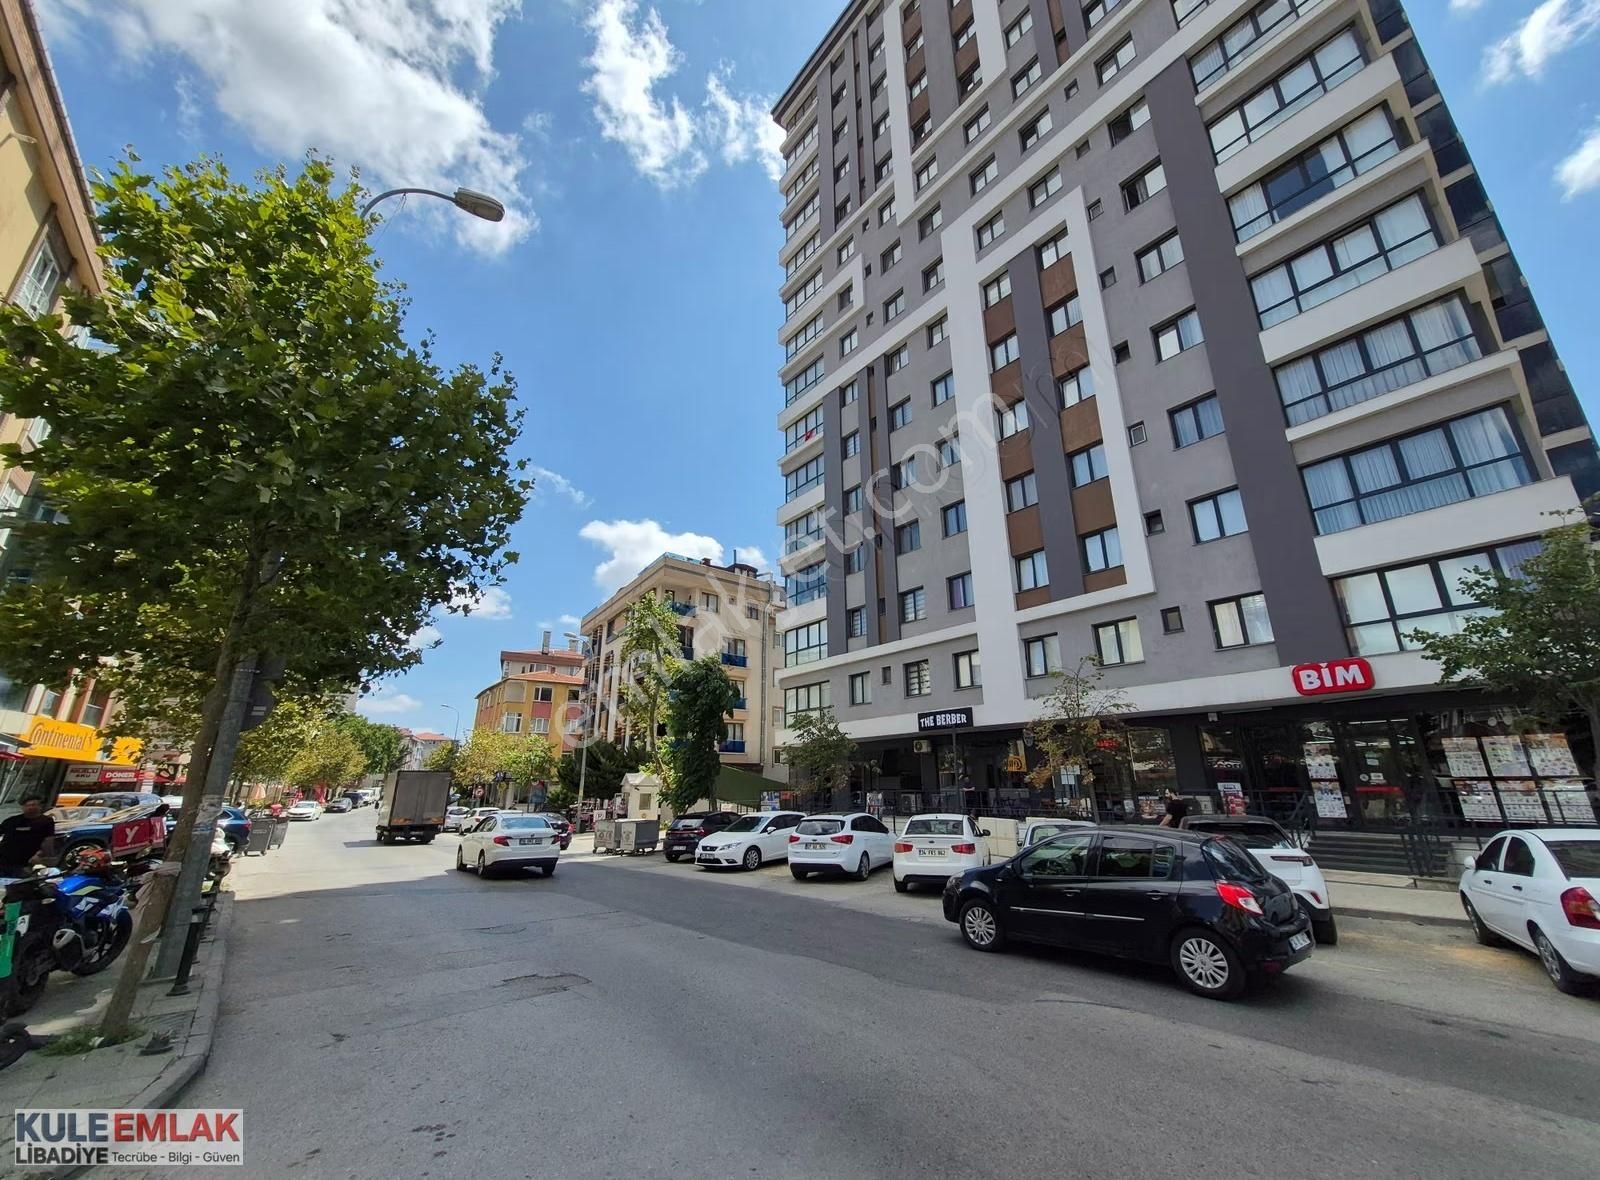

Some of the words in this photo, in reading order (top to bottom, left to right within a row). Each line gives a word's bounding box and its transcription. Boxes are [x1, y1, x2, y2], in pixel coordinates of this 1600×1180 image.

[920, 715, 935, 728] THE
[936, 713, 967, 726] BERBER
[30, 723, 86, 751] Continental
